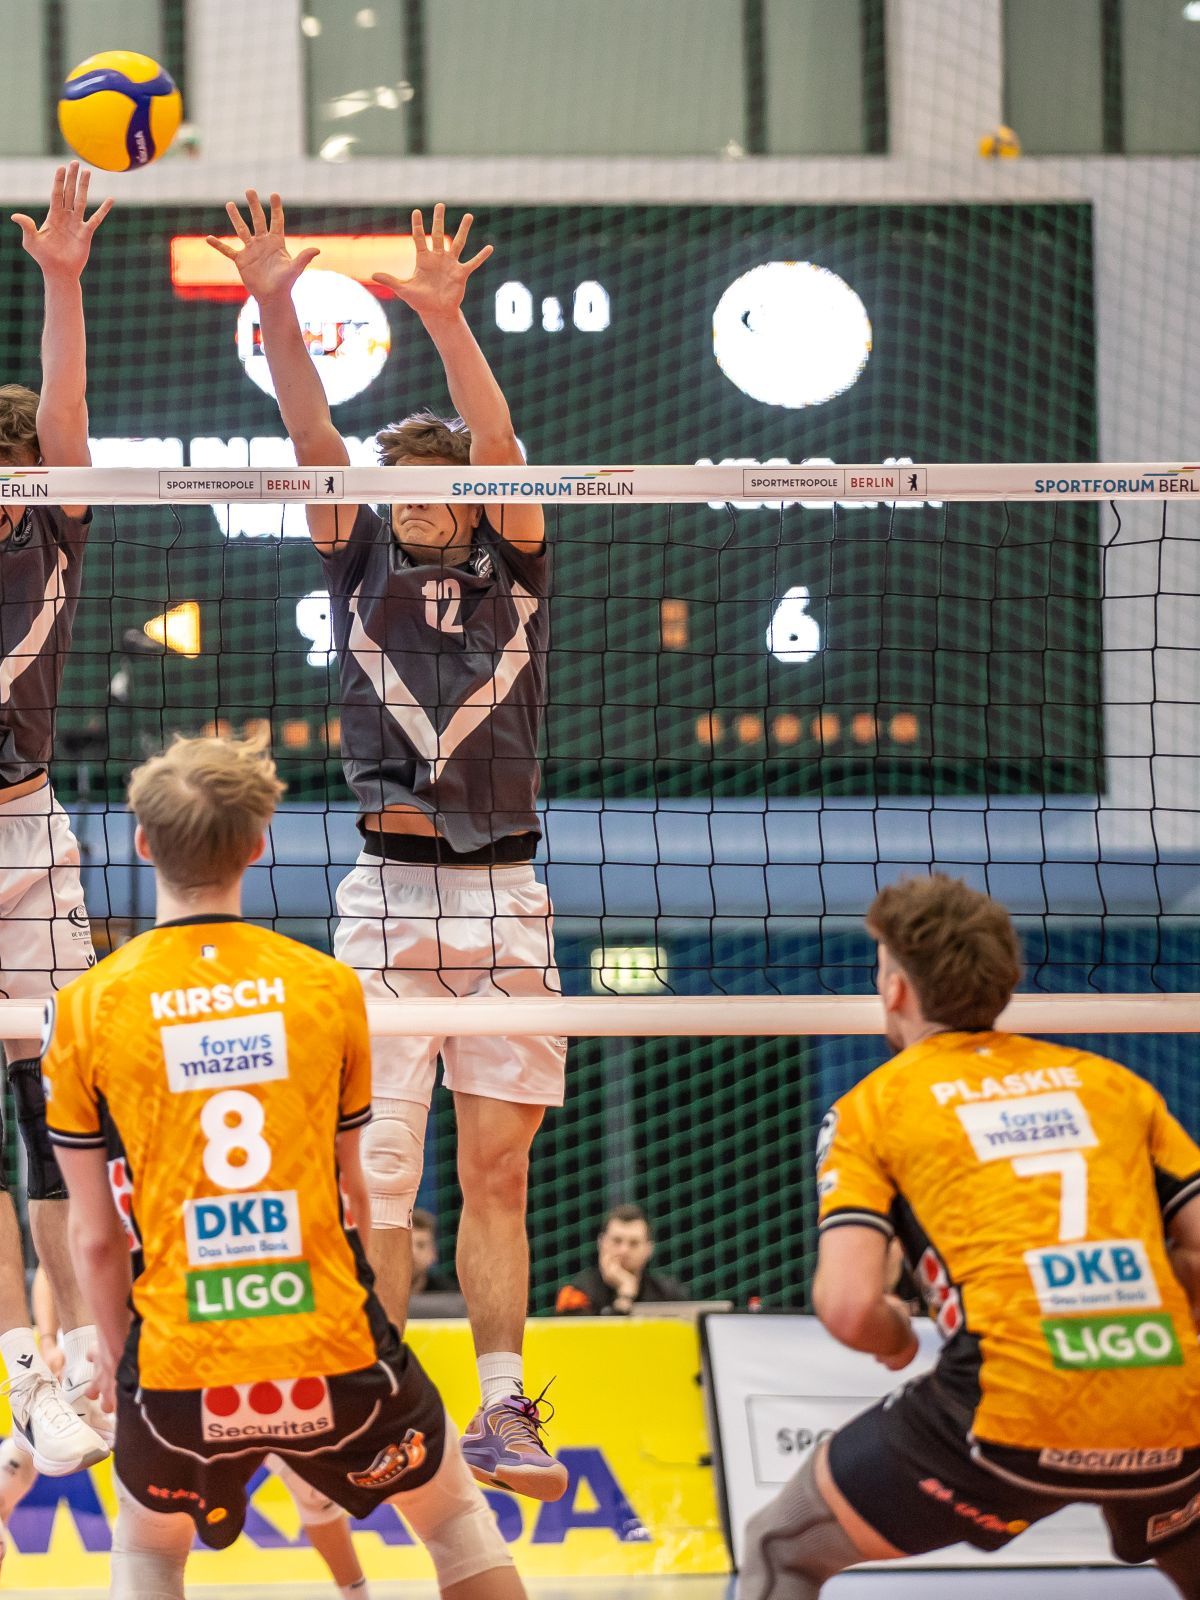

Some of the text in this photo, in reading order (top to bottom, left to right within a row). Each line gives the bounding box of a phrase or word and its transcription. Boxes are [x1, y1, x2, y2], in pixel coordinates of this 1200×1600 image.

[166, 479, 311, 491] SPORTMETROPOLE BERLIN
[451, 482, 633, 496] SPORTFORUM BERLIN
[750, 477, 895, 489] SPORTMETROPOLE BERLIN
[1034, 479, 1155, 493] SPORTFORUM
[421, 579, 464, 633] 12
[766, 586, 820, 662] 6
[150, 977, 285, 1020] KIRSCH
[180, 1051, 274, 1077] mazars
[200, 1034, 272, 1056] forvis
[930, 1066, 1082, 1105] PLASKIE
[200, 1090, 271, 1189] 8
[984, 1121, 1080, 1146] mazars
[1010, 1152, 1087, 1242] 7
[194, 1198, 288, 1239] DKB
[259, 1240, 289, 1252] Bank
[1041, 1247, 1142, 1288] DKB
[195, 1272, 304, 1314] LIGO
[1052, 1321, 1173, 1362] LIGO
[207, 1417, 330, 1438] Securitas
